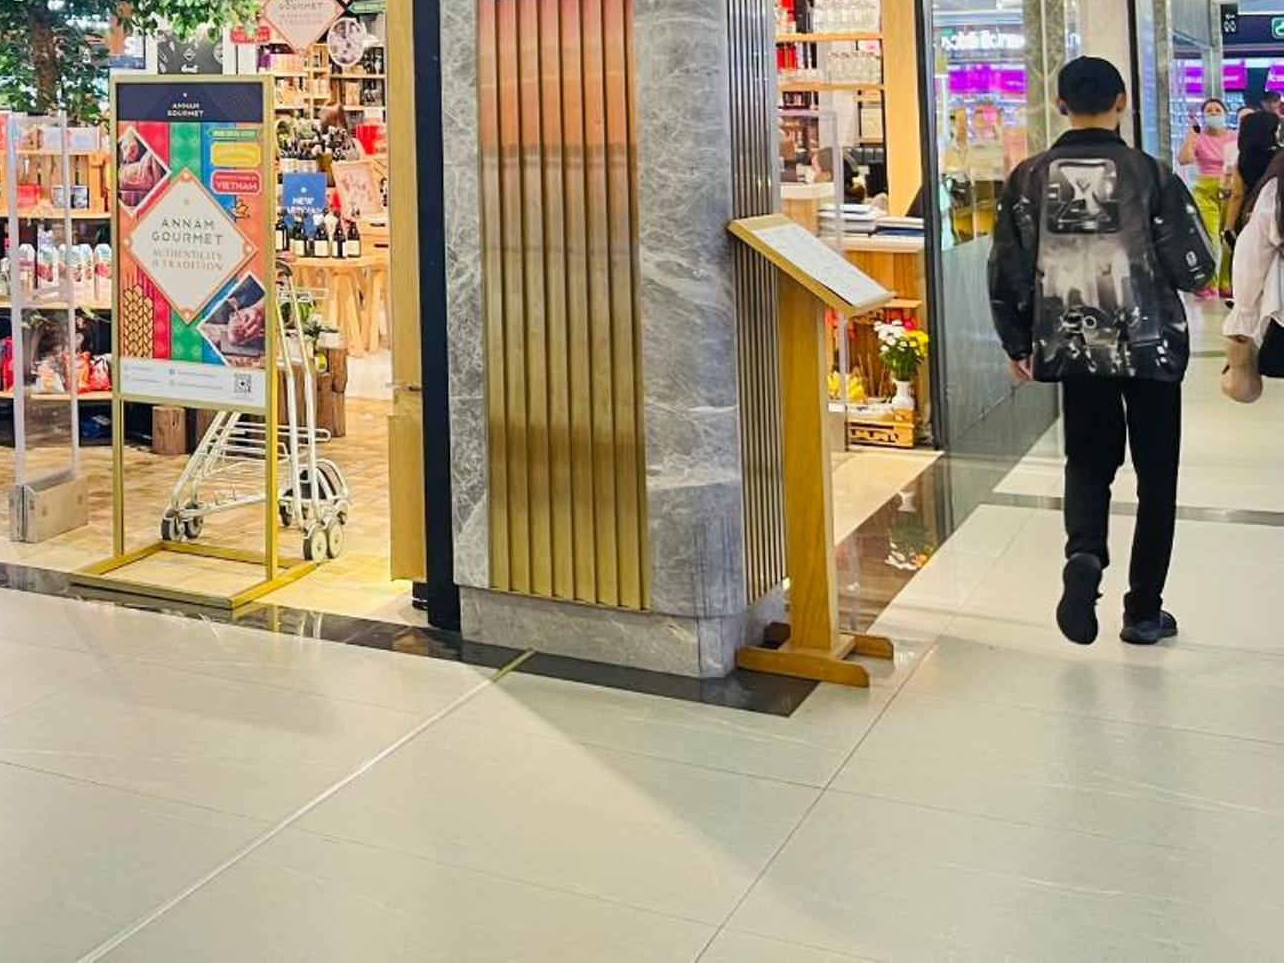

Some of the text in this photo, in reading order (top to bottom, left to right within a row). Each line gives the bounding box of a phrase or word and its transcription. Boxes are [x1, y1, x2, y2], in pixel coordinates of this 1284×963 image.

[172, 102, 200, 110] ANNAM
[215, 181, 258, 191] VIETNAM
[162, 218, 215, 231] ANNAM
[152, 231, 224, 246] GOURMET
